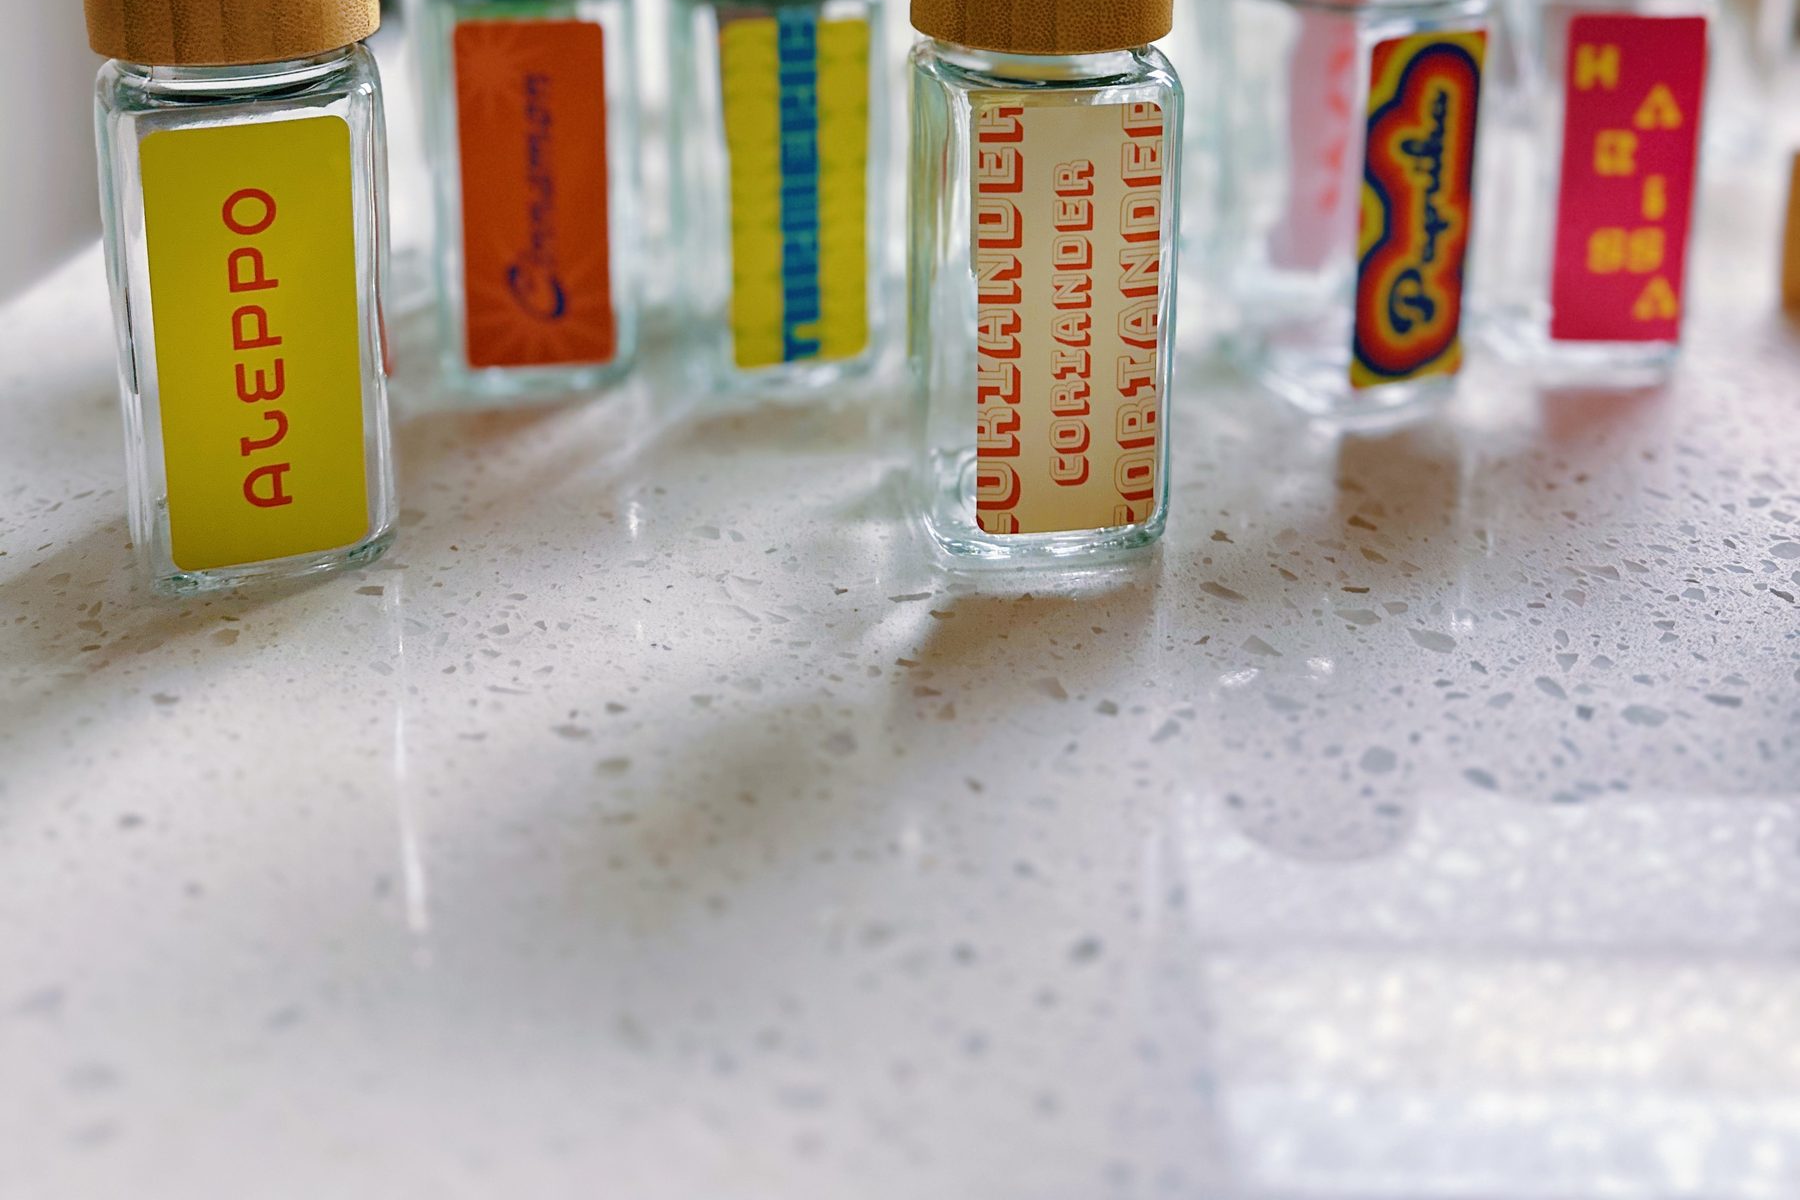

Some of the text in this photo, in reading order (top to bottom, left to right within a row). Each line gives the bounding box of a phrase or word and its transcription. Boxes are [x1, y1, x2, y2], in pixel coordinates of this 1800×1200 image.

[222, 187, 293, 509] ALEPPO
[1049, 158, 1094, 486] CORIANDER
[1389, 88, 1449, 335] Paprika
